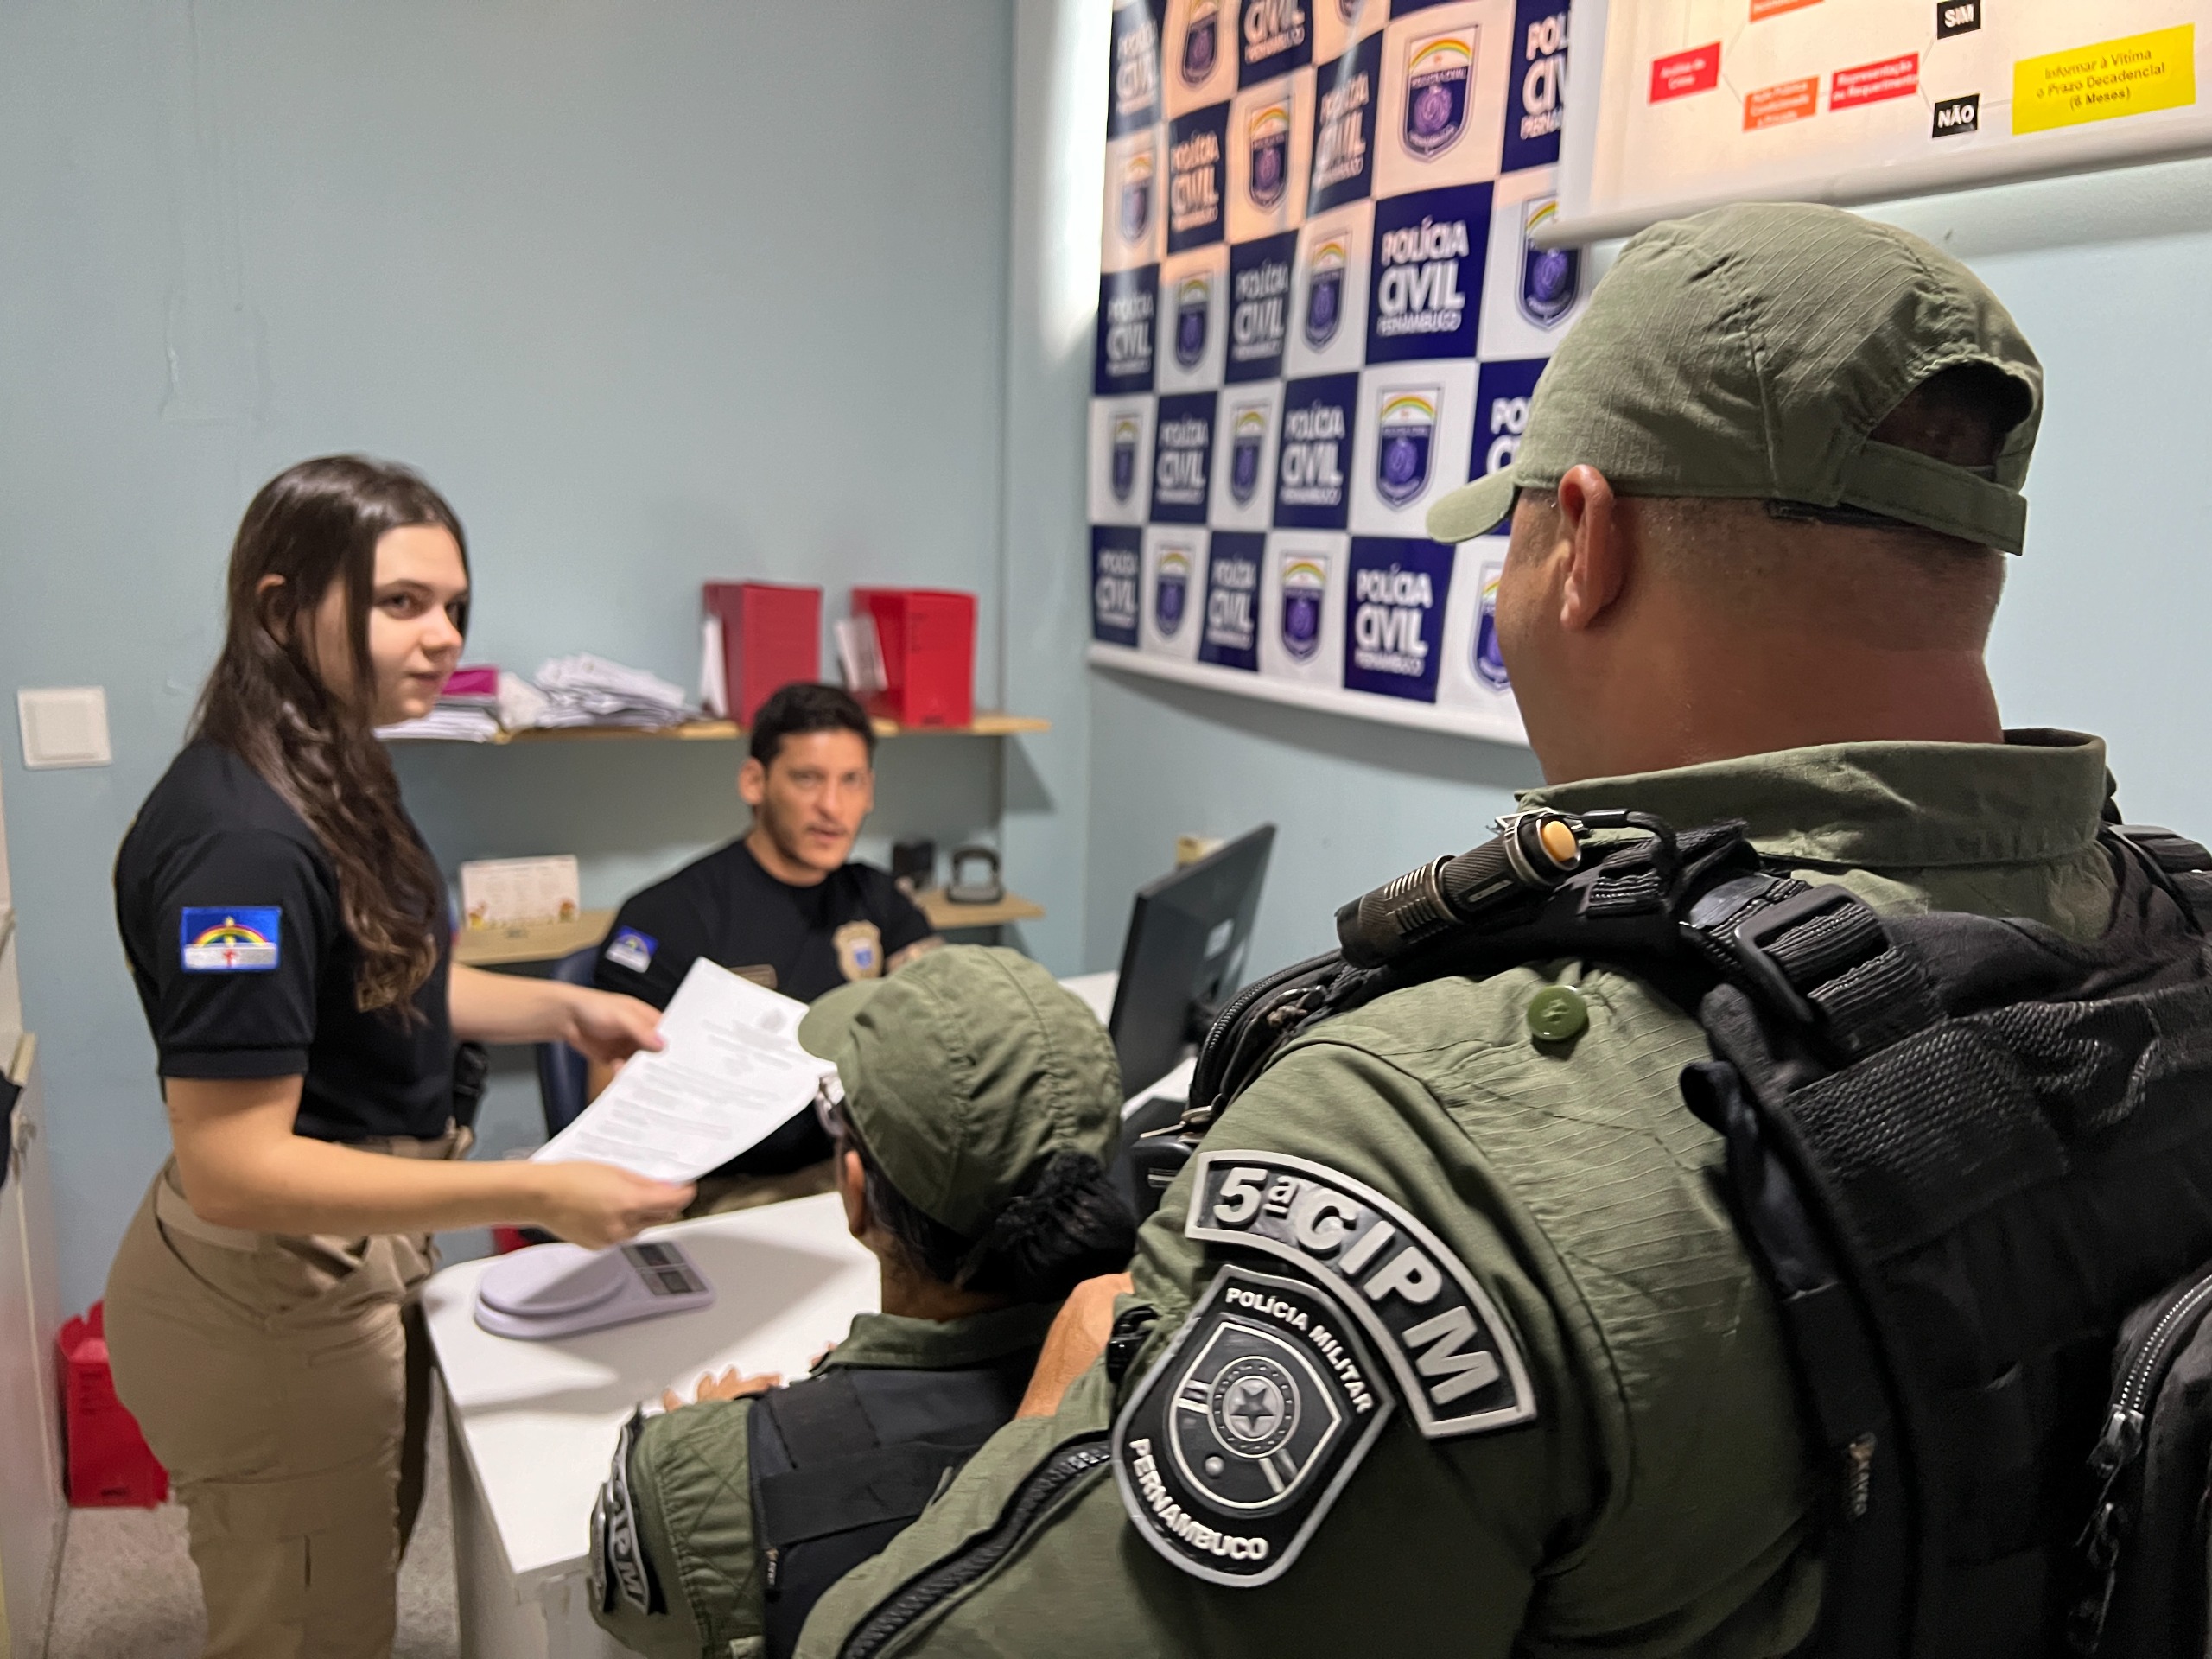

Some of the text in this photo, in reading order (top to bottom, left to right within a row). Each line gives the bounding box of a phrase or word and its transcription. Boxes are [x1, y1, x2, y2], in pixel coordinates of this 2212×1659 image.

[1944, 3, 1974, 28] SIM
[2044, 60, 2097, 79] Informar
[2087, 61, 2165, 88] Decadencial
[1937, 105, 1974, 128] NÃO
[1381, 215, 1470, 266] POLÍCIA
[1378, 258, 1466, 317] CIVIL
[1281, 440, 1344, 486] CIVIL
[1356, 562, 1433, 609] POLÍCIA
[1354, 602, 1429, 658] CIVIL
[1294, 1194, 1501, 1407] CIPM
[1308, 1324, 1374, 1414] MILITAR
[1129, 1437, 1268, 1560] PERNAMBUCO
